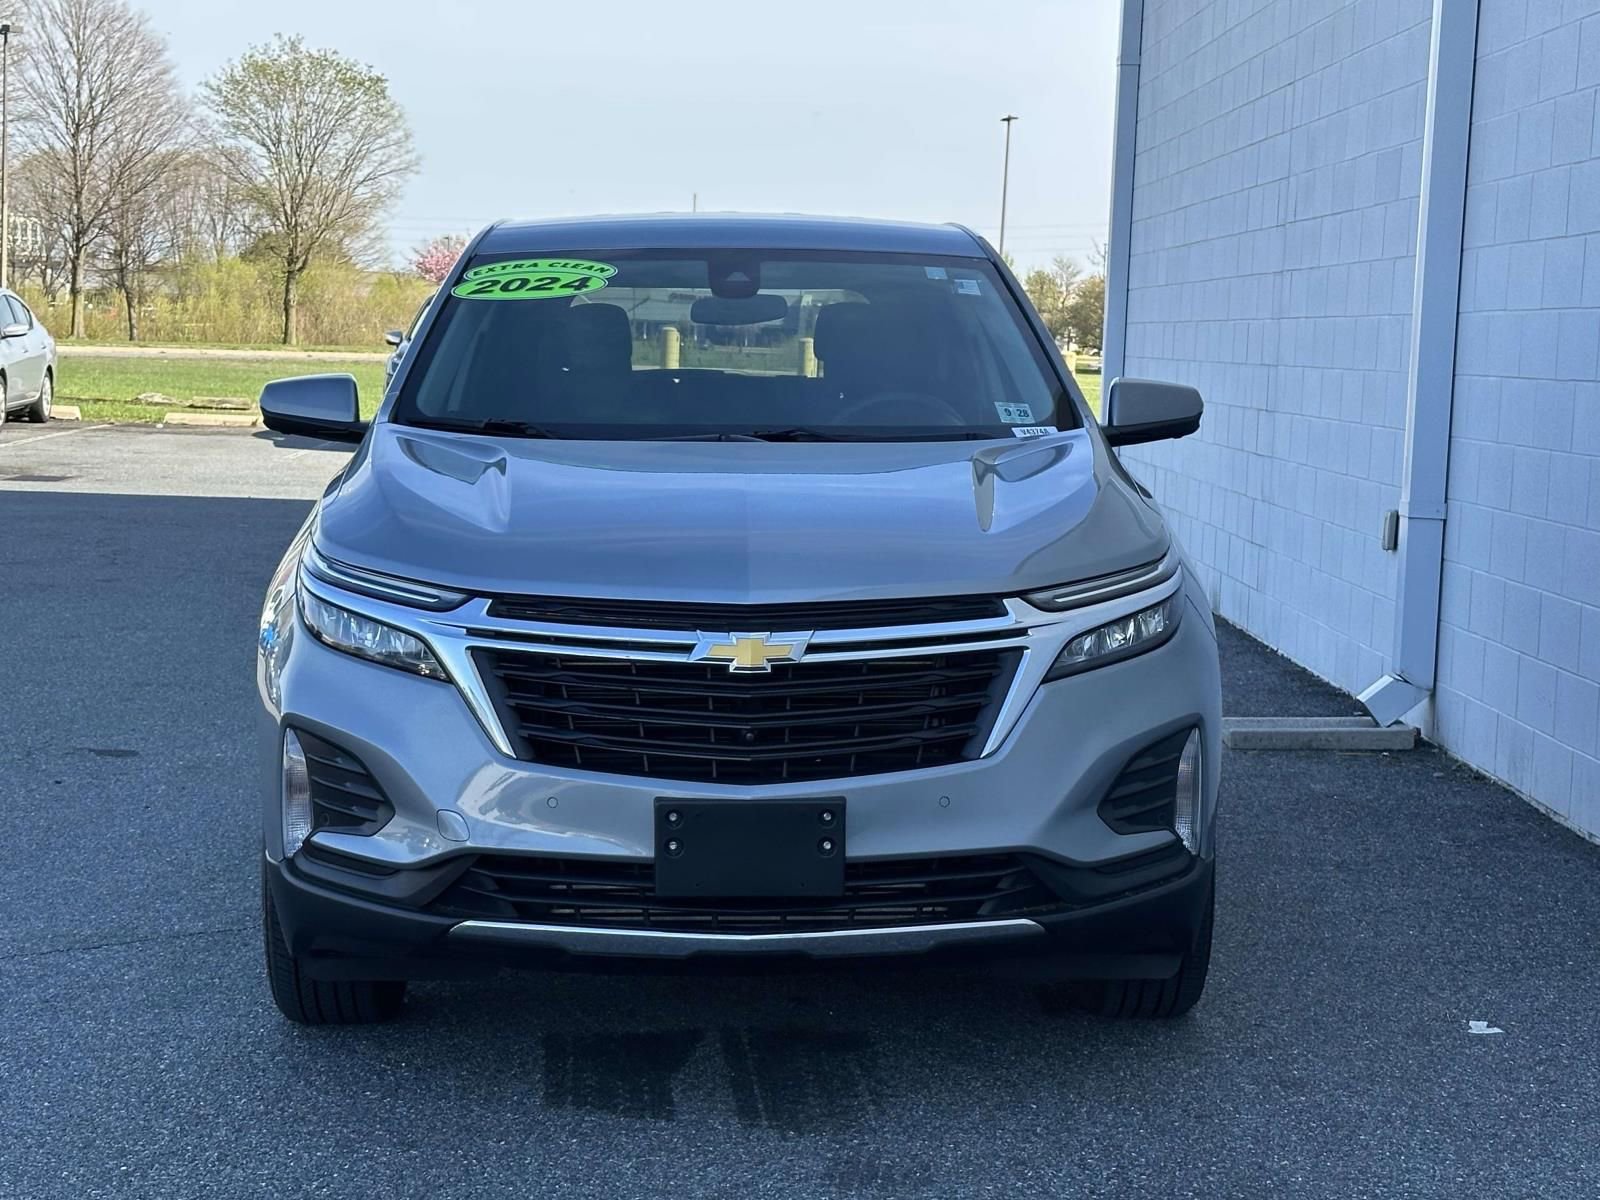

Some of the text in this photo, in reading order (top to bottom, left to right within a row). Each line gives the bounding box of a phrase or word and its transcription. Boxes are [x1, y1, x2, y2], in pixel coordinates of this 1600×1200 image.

[473, 262, 610, 276] EXTRA CLEAN
[465, 276, 593, 295] 2024
[1016, 409, 1030, 417] 28
